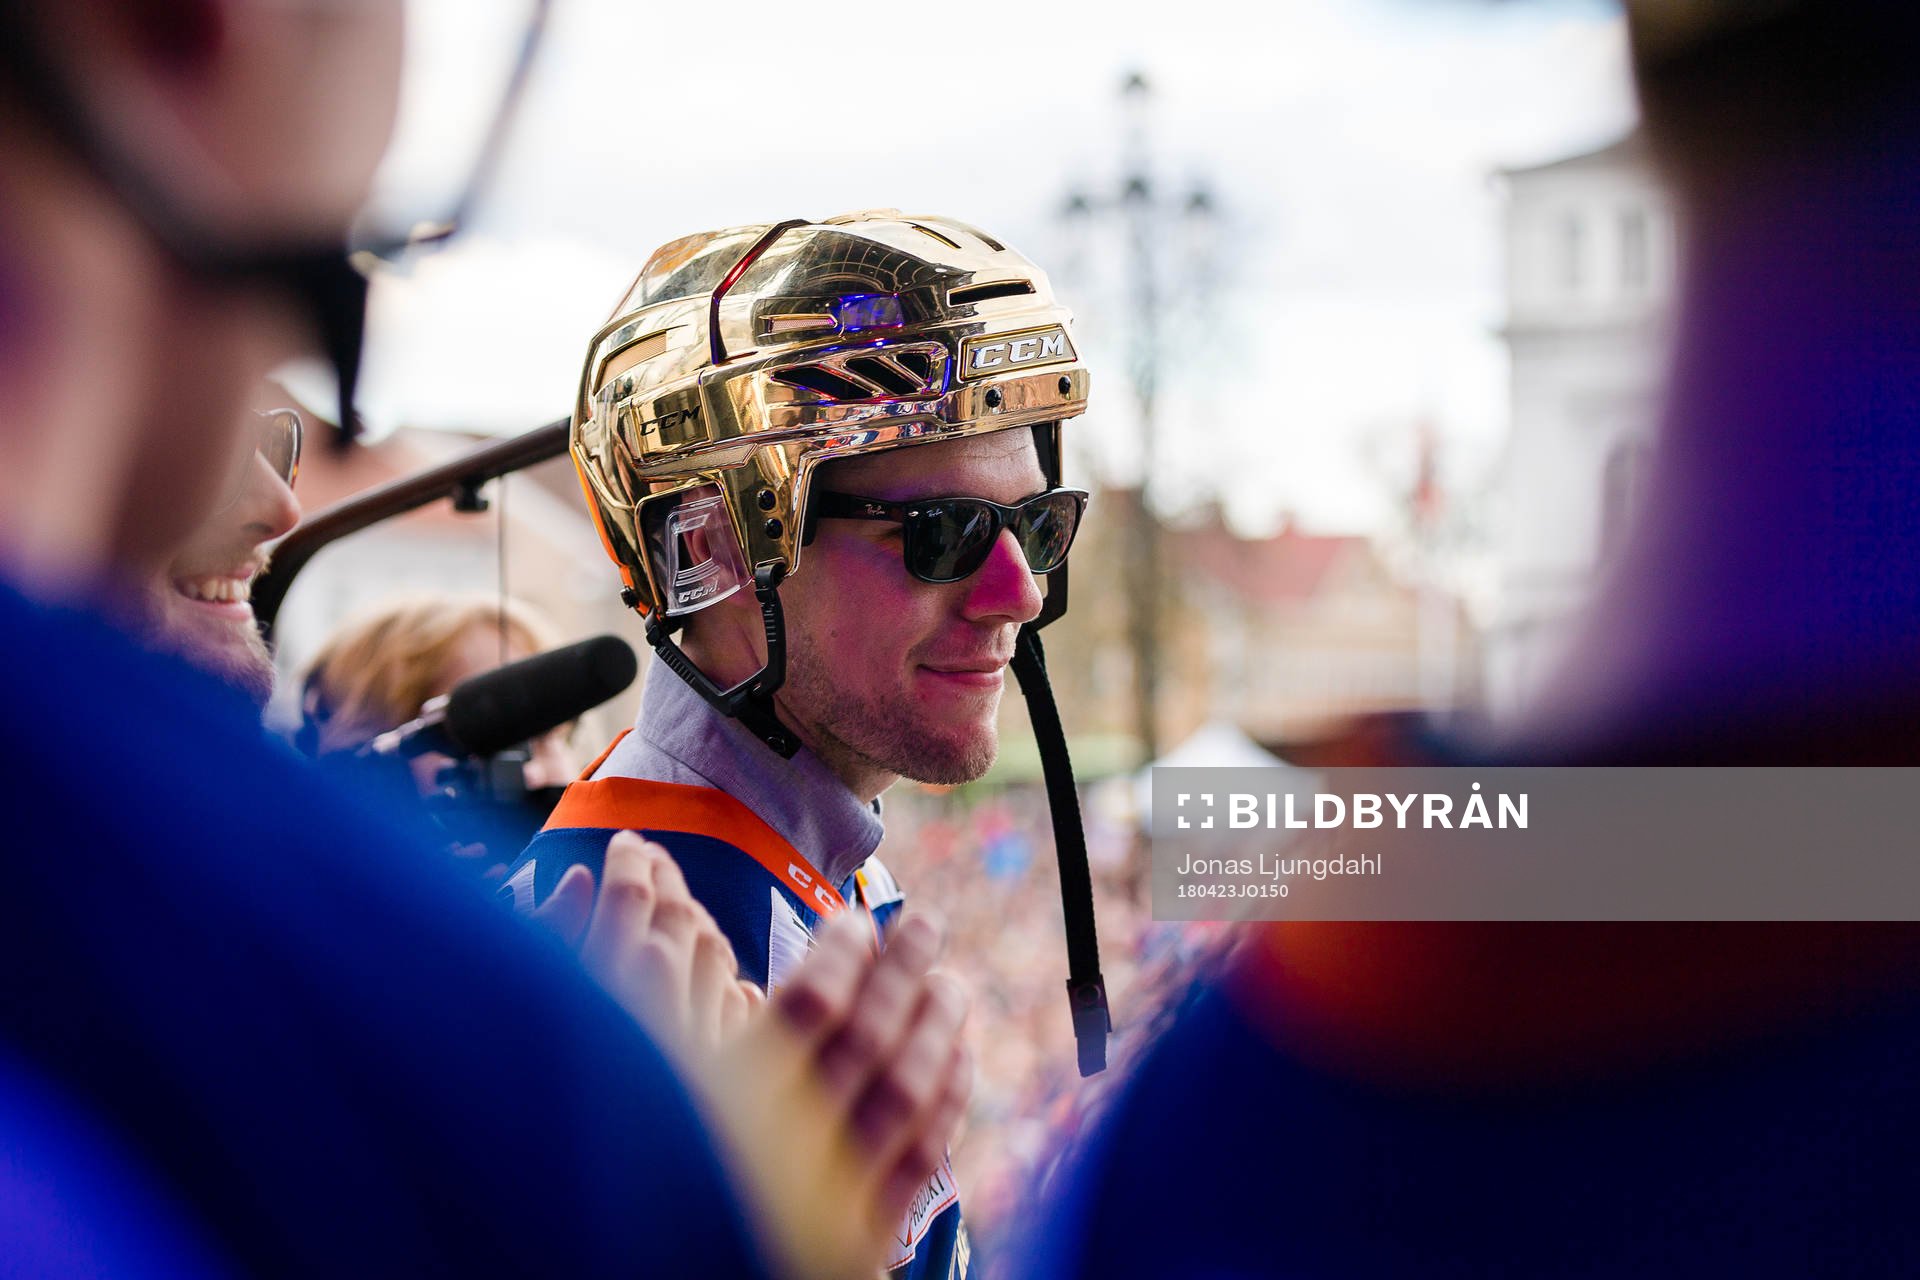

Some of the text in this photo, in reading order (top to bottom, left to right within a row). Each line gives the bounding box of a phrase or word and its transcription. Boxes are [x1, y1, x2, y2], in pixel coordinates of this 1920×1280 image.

[971, 334, 1065, 369] CCM
[640, 405, 701, 437] CCM
[678, 577, 719, 604] CCM
[787, 861, 838, 913] CC
